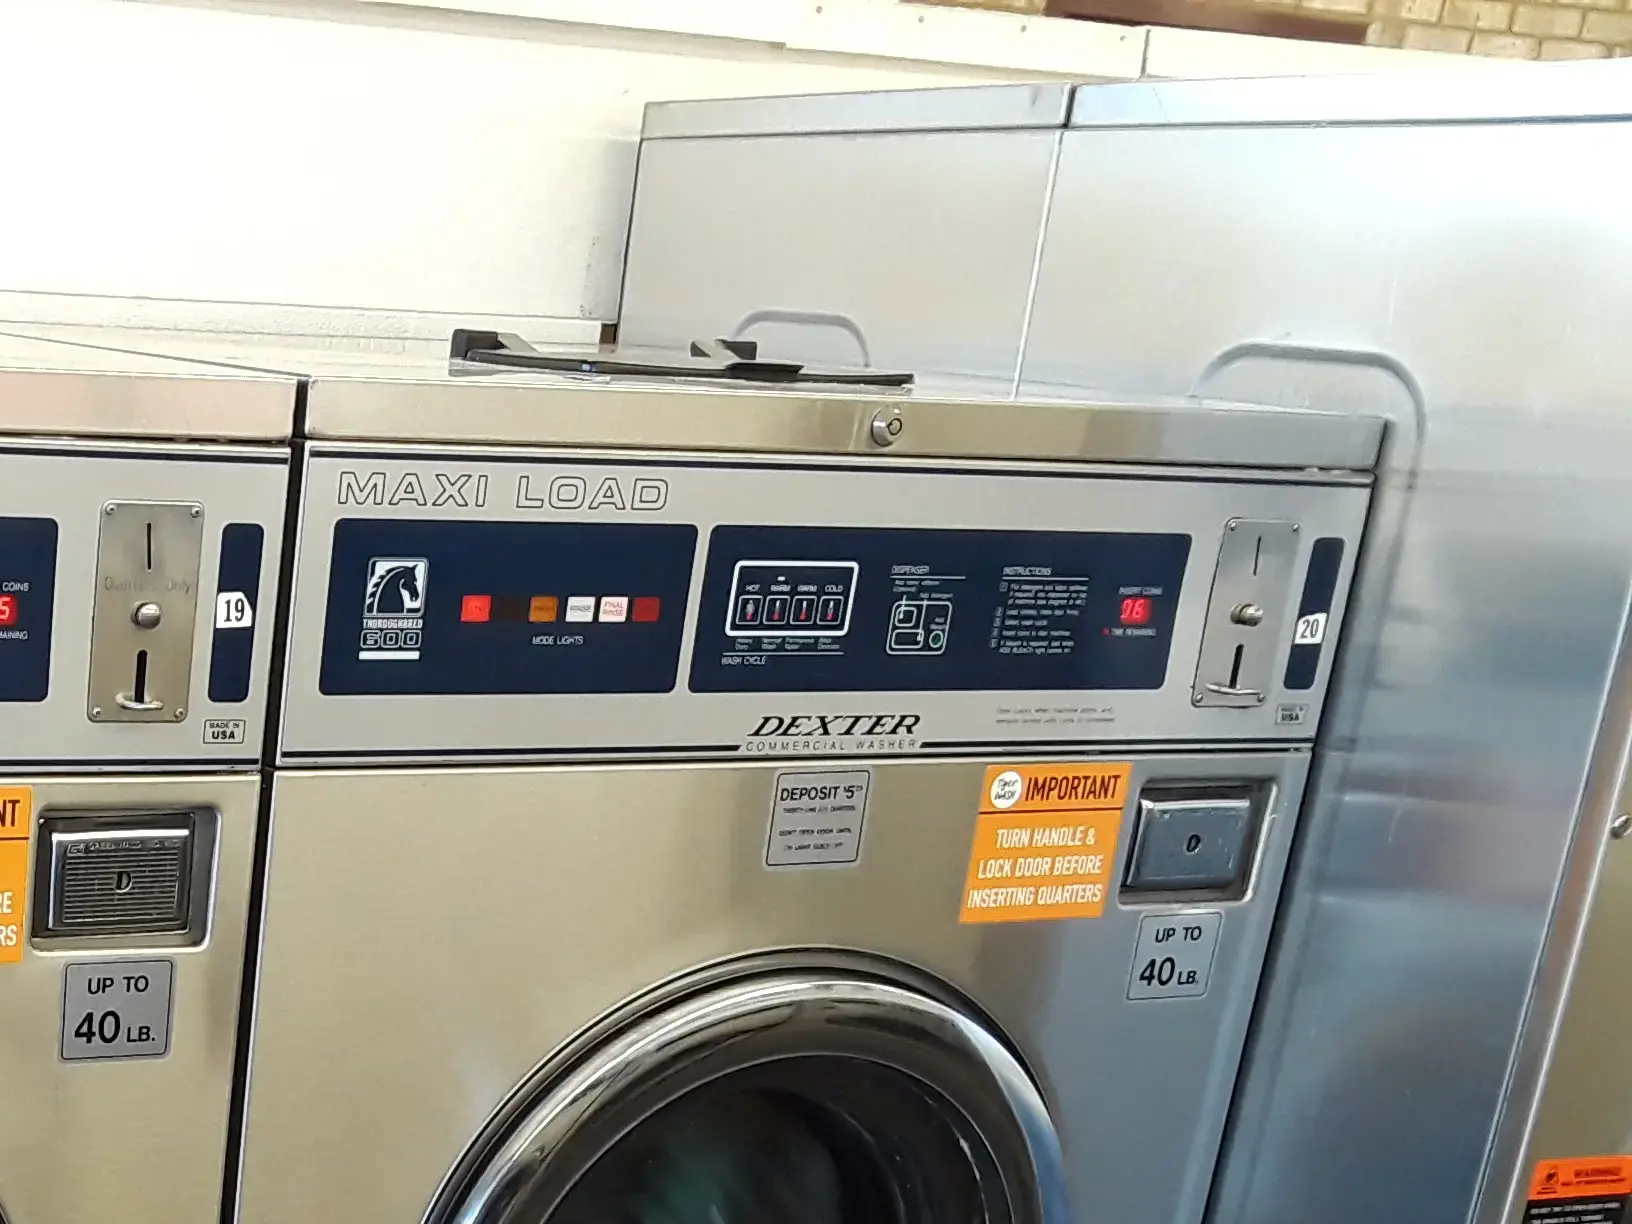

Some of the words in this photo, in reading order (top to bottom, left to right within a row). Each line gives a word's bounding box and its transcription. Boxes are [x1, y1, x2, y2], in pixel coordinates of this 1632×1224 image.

[338, 471, 489, 508] MAXI
[516, 474, 669, 512] LOAD
[2, 582, 30, 592] COINS
[824, 585, 843, 593] COLD
[224, 598, 245, 622] 19
[1299, 618, 1319, 639] 20
[360, 630, 422, 648] 600
[531, 635, 554, 645] MODE
[557, 635, 584, 646] LIGHTS
[746, 714, 921, 737] DEXTER
[1280, 711, 1300, 721] USA
[211, 730, 236, 740] USA
[746, 741, 846, 752] COMMERCIAL
[856, 739, 917, 750] WASHER
[779, 785, 841, 802] DEPOSIT
[1024, 775, 1122, 802] IMPORTANT
[996, 827, 1031, 850] TURN
[1031, 825, 1086, 848] HANDLE
[1085, 827, 1096, 846] &
[977, 858, 1014, 880] LOCK
[1014, 856, 1052, 878] DOOR
[1052, 854, 1104, 876] BEFORE
[966, 885, 1036, 909] INSERTING
[1037, 883, 1103, 906] QUARTERS
[1154, 927, 1176, 944] UP
[1182, 925, 1203, 941] TO
[1139, 957, 1176, 987] 40
[1177, 970, 1200, 985] LB.
[87, 976, 114, 994] UP
[123, 975, 149, 992] TO
[74, 1011, 121, 1045] 40
[126, 1025, 156, 1043] LB.
